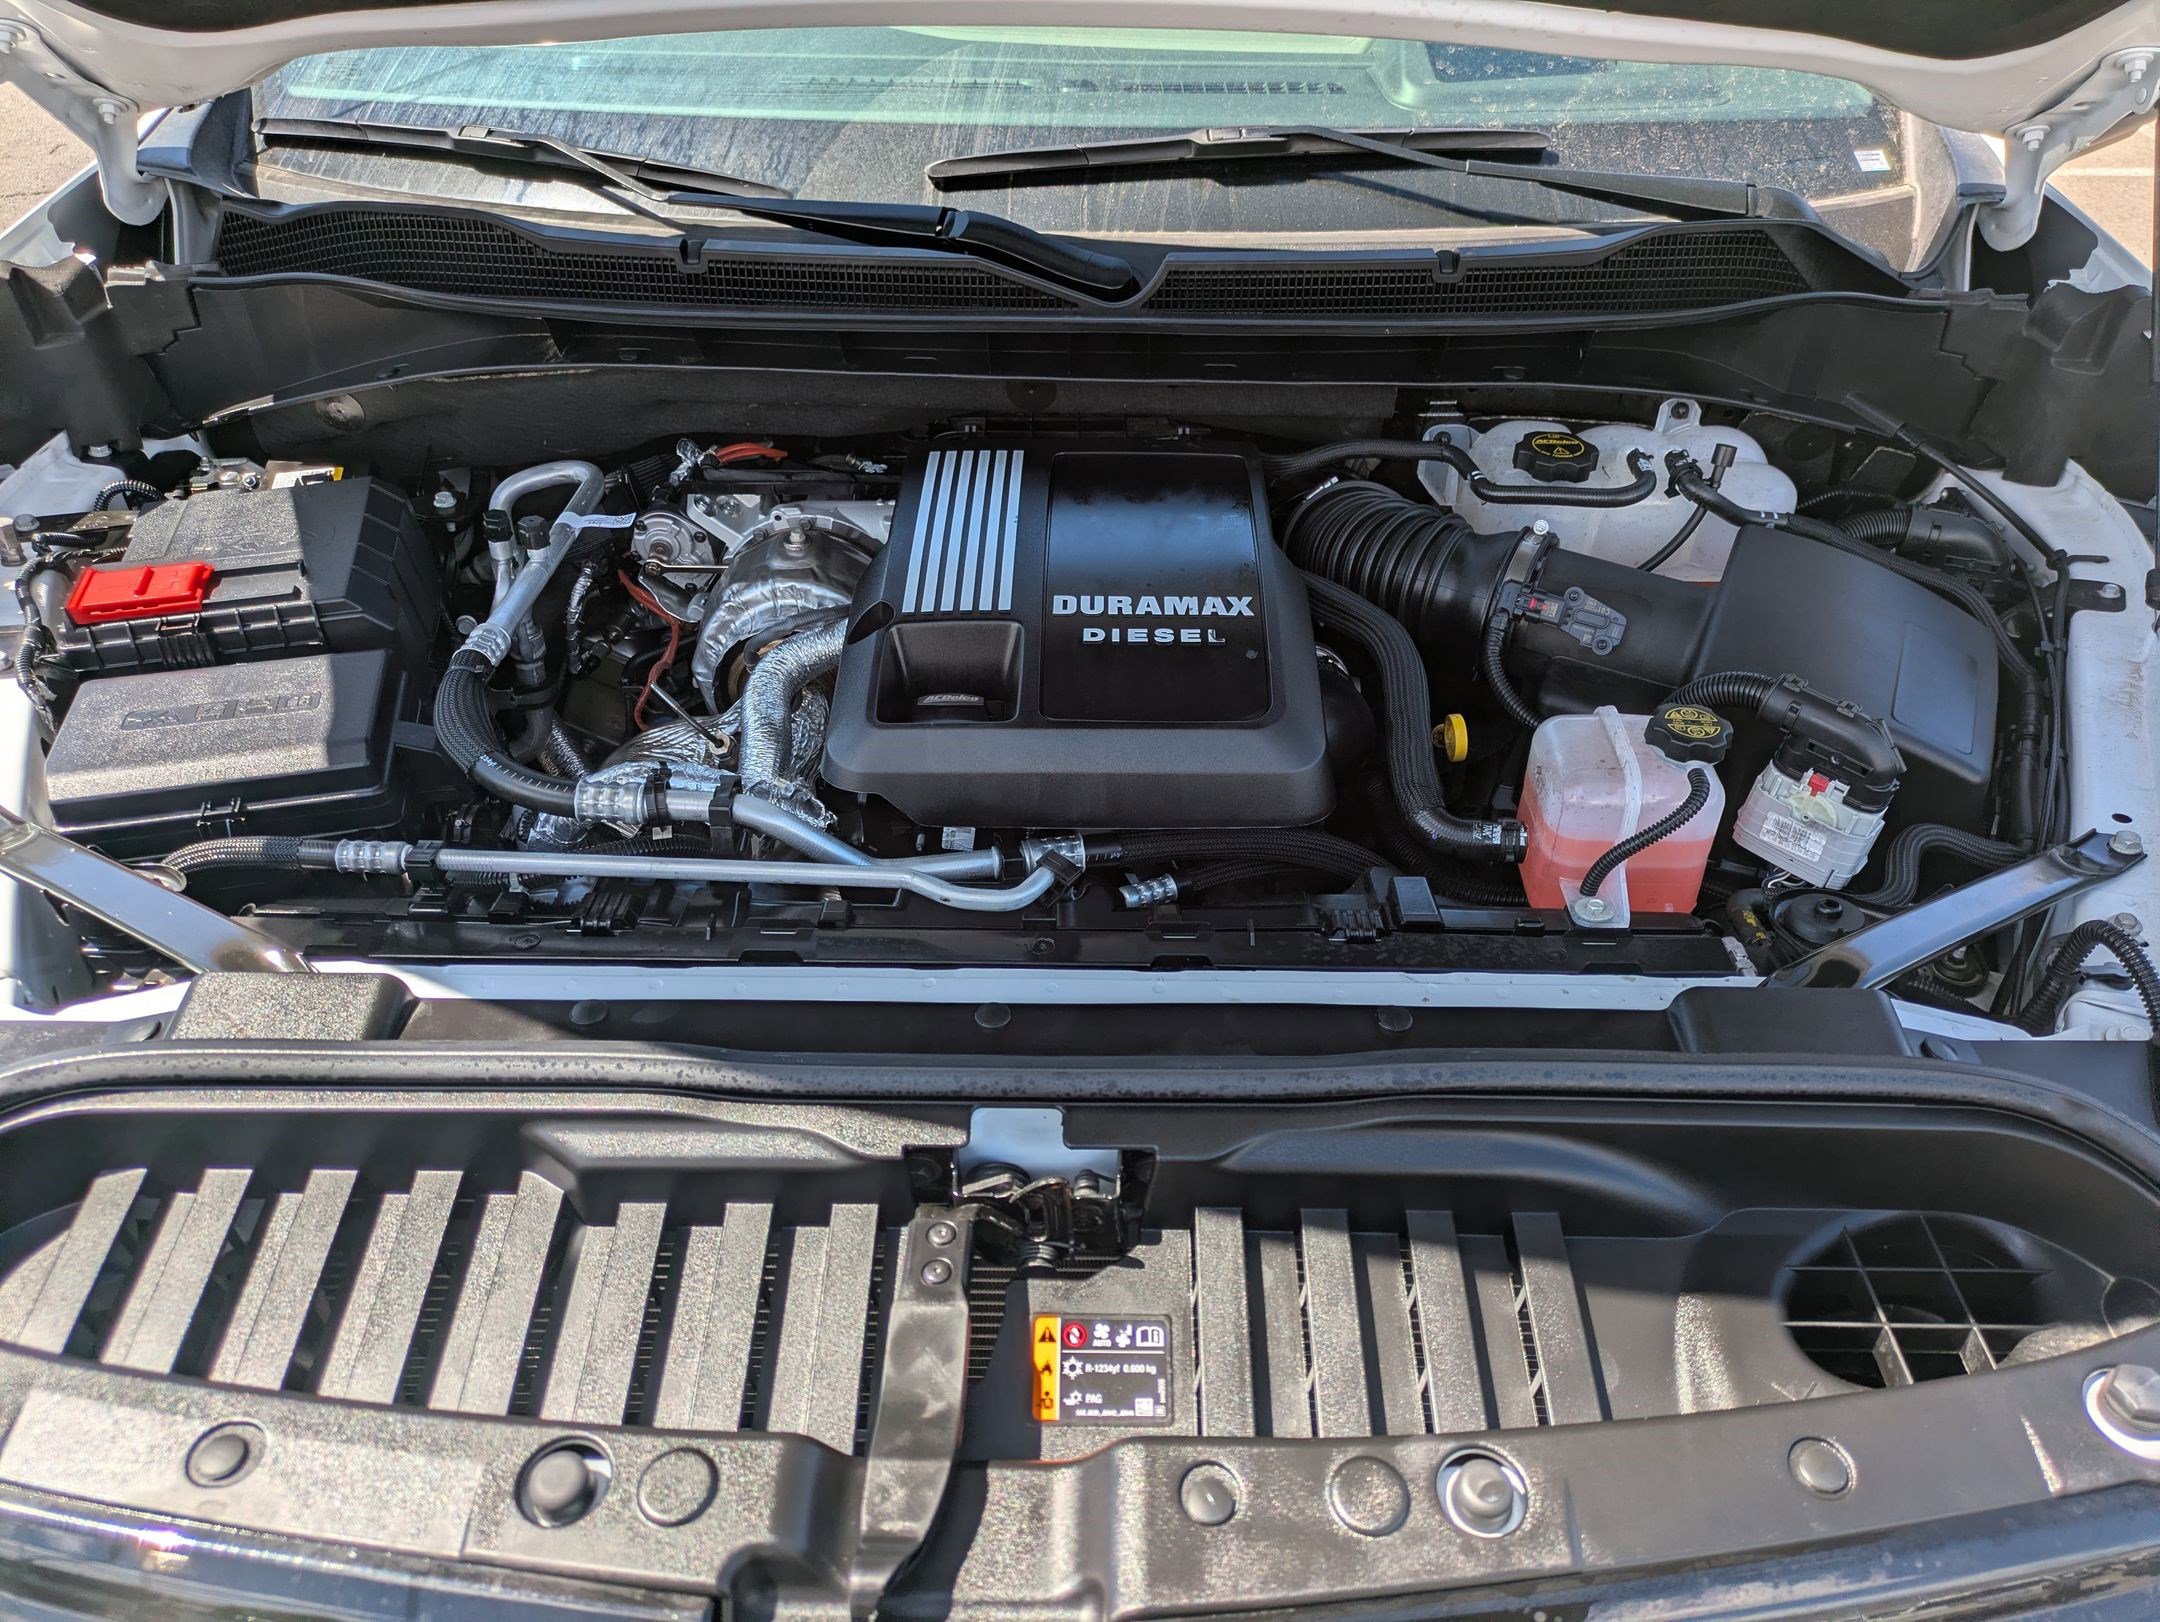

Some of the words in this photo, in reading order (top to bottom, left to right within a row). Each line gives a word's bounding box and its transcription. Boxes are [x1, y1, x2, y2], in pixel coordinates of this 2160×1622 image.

[1052, 595, 1255, 616] DURAMAX
[1083, 628, 1226, 644] DIESEL
[922, 693, 979, 704] ACDelco
